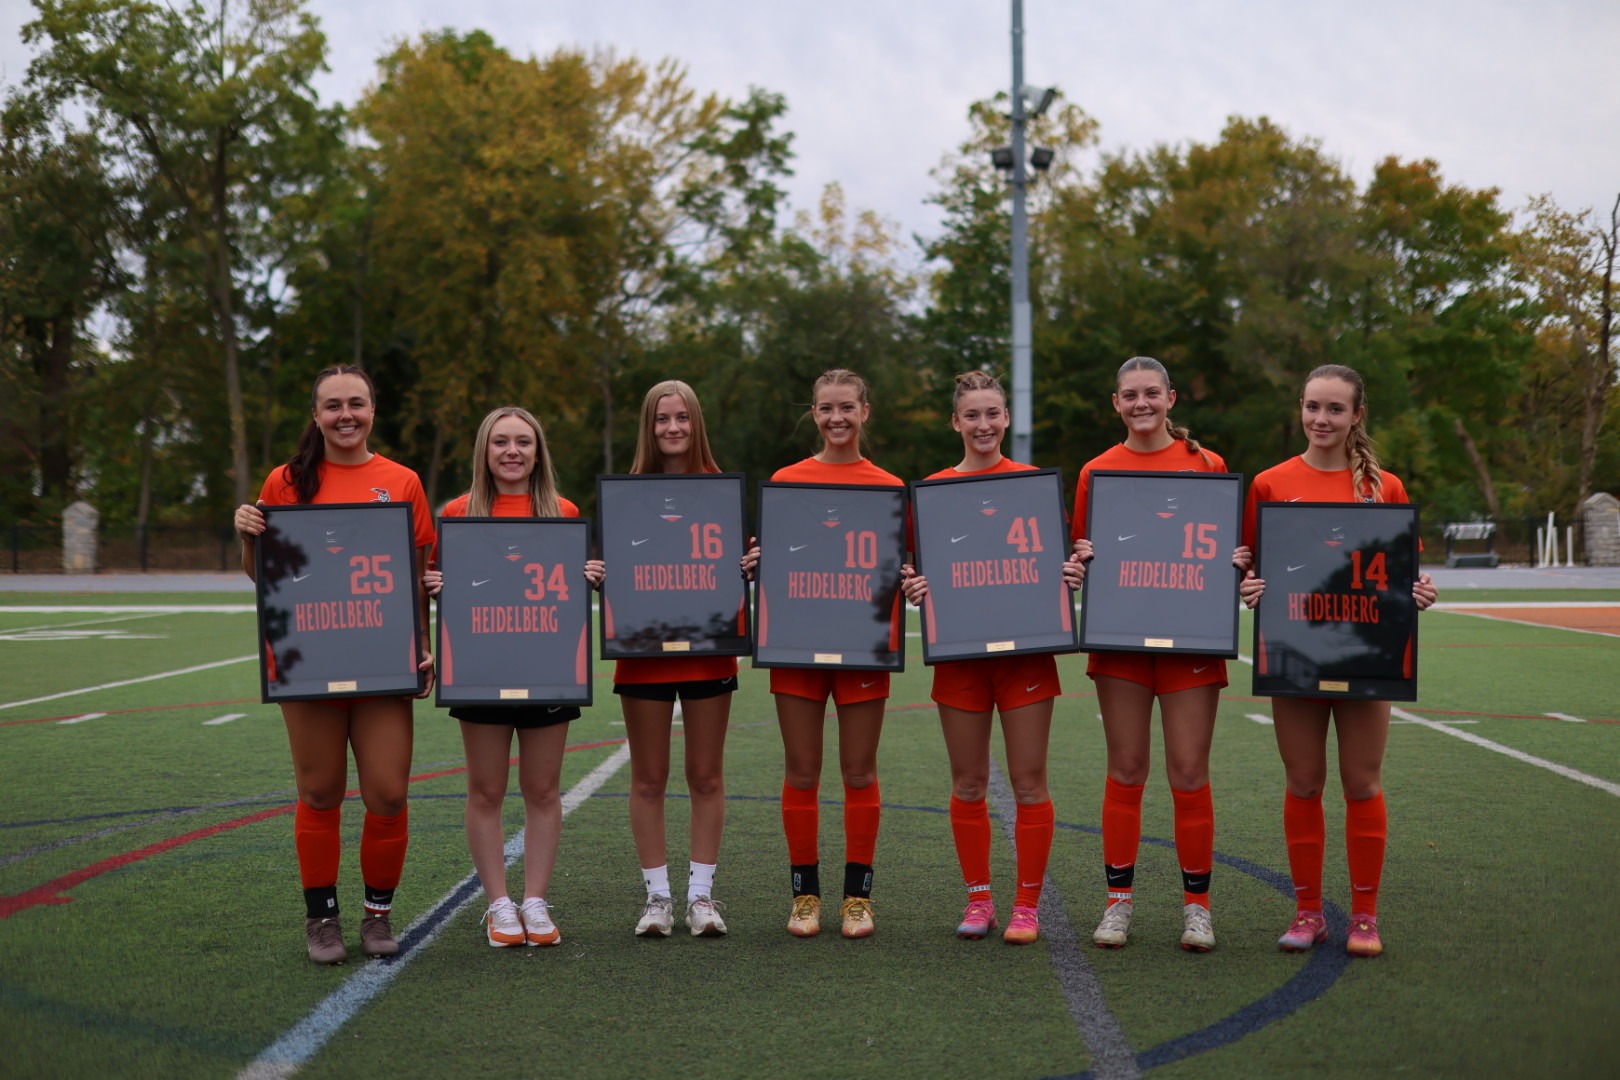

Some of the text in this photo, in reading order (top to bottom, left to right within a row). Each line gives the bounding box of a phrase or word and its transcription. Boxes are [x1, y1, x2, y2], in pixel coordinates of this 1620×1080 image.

[690, 523, 723, 559] 16
[845, 530, 877, 569] 10
[1006, 516, 1044, 553] 41
[1182, 522, 1218, 560] 15
[350, 555, 394, 595] 25
[523, 563, 569, 601] 34
[633, 564, 717, 591] HEIDELBERG
[788, 571, 872, 601] HEIDELBERG
[952, 557, 1039, 588] HEIDELBERG
[1119, 561, 1204, 591] HEIDELBERG
[1350, 550, 1389, 591] 14
[295, 599, 383, 631] HEIDELBERG
[471, 606, 558, 633] HEIDELBERG
[1288, 592, 1379, 624] HEIDELBERG
